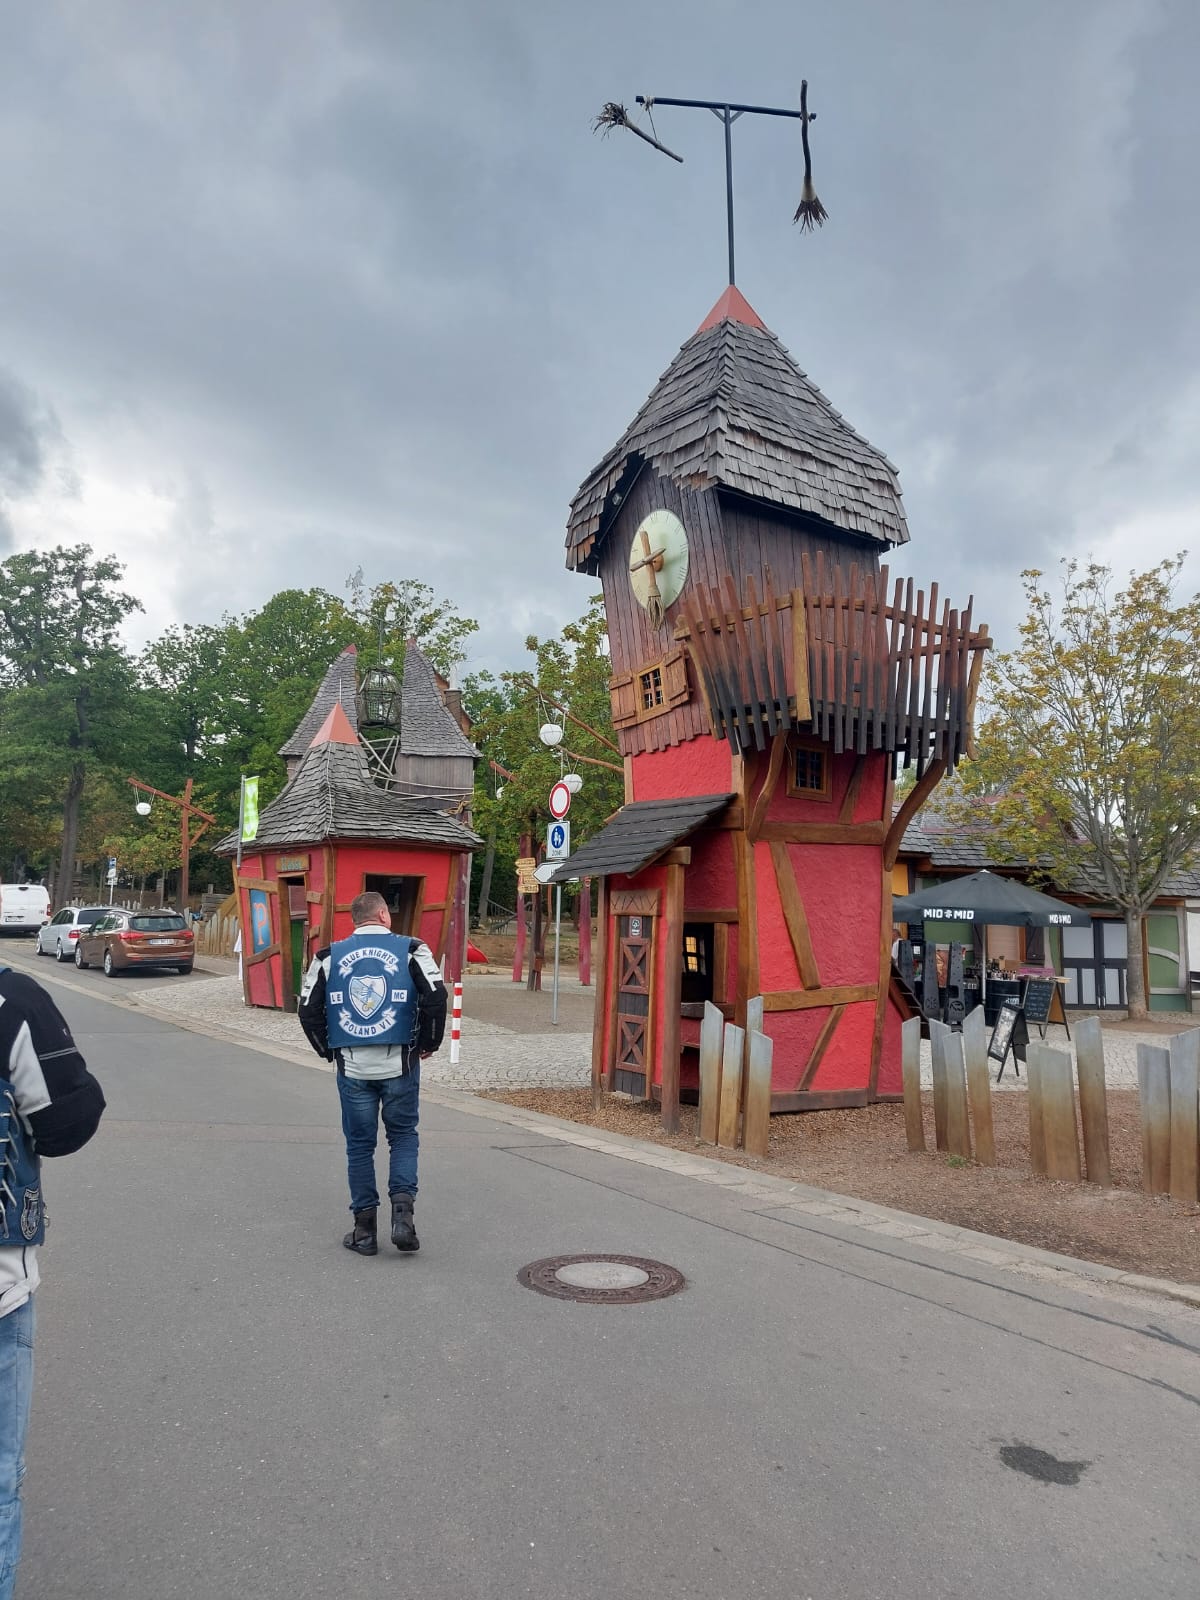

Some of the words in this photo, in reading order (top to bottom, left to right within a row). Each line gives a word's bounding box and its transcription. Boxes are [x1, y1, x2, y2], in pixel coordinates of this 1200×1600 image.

[923, 908, 943, 919] MIO
[953, 910, 975, 920] MIO
[342, 951, 360, 967] BLUE
[362, 949, 396, 964] KNIGHTS
[331, 994, 342, 1002] LE
[393, 991, 405, 1000] MC
[343, 1021, 377, 1035] POLAND
[379, 1019, 391, 1029] VI
